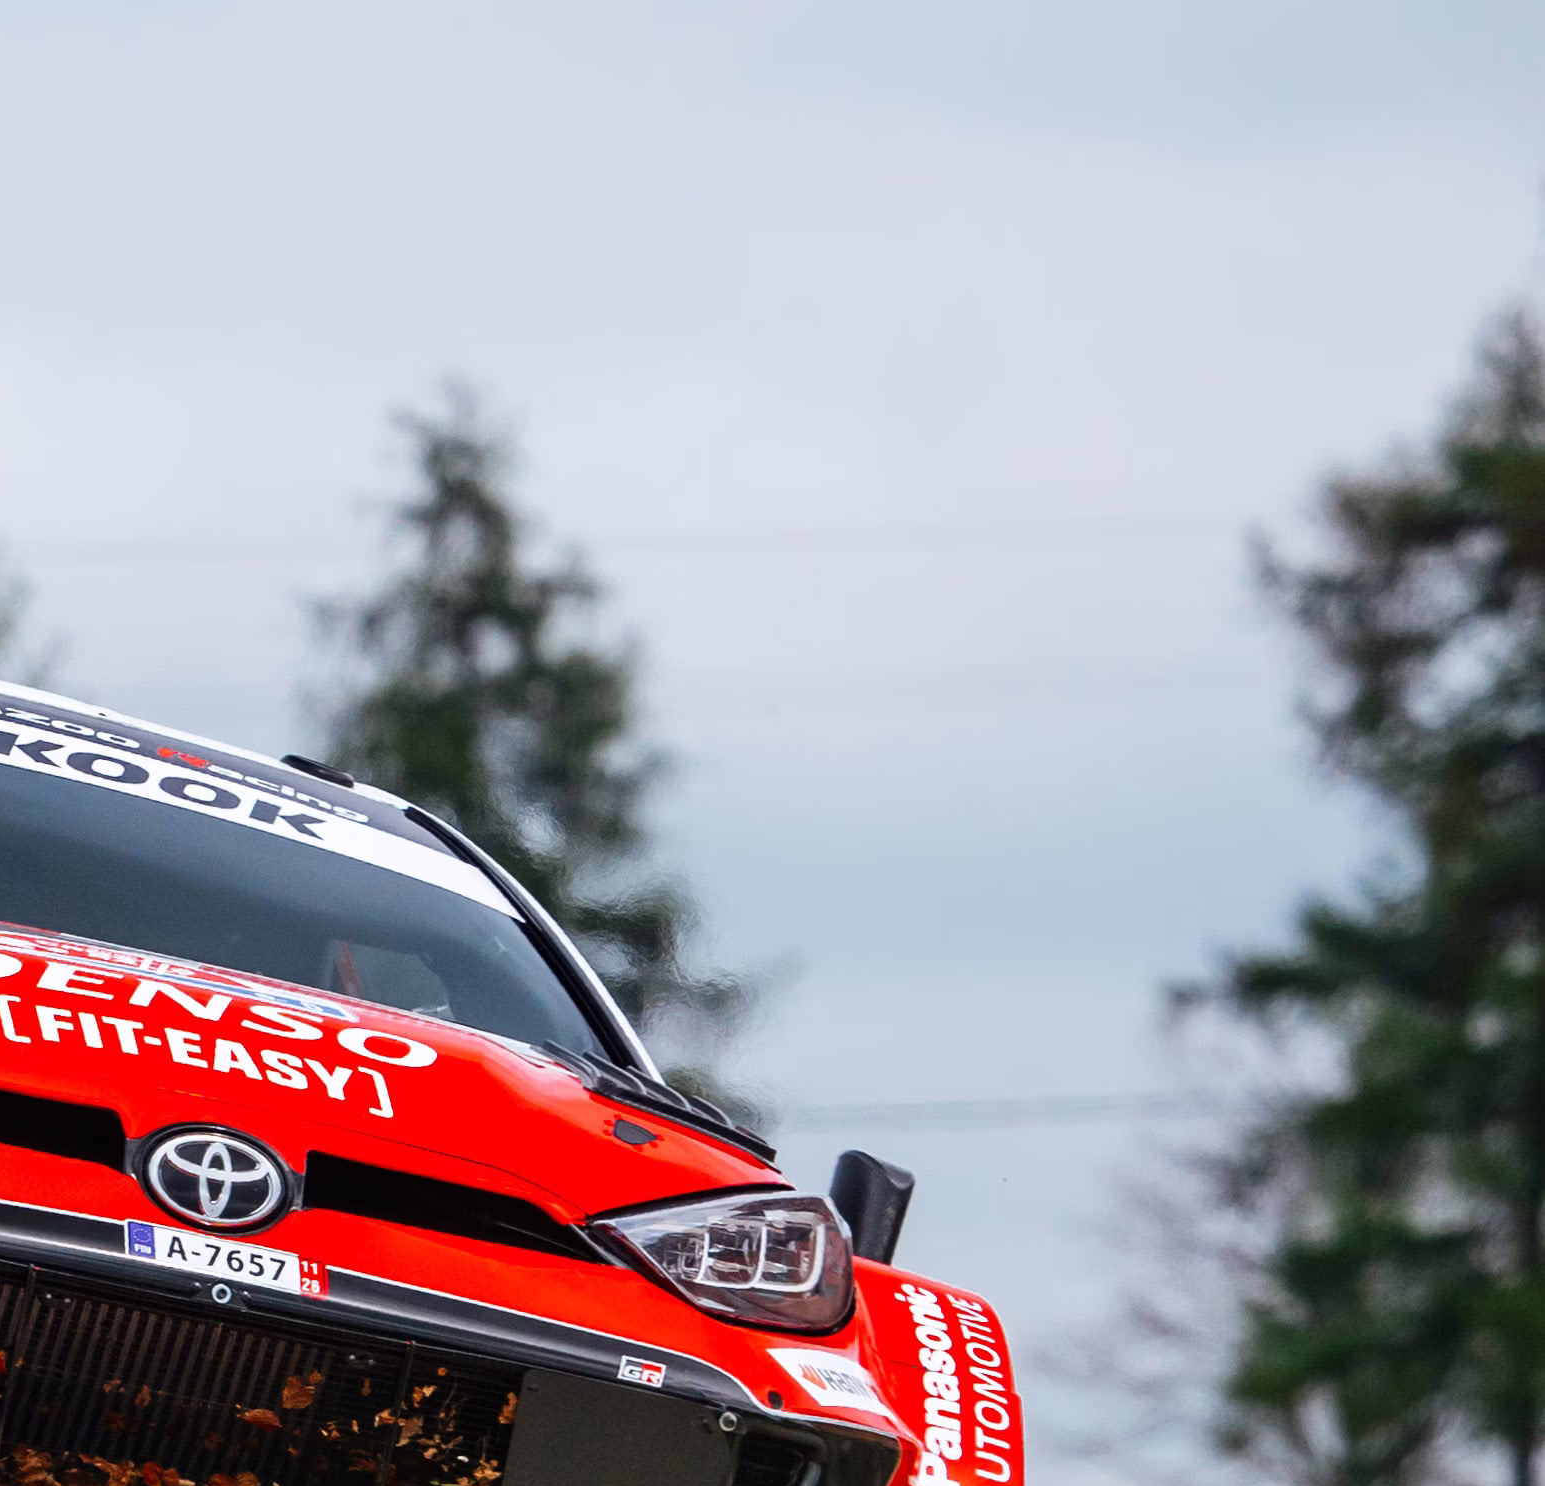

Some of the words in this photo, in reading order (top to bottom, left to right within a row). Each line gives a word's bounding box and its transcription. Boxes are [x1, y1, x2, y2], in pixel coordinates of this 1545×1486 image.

[156, 745, 370, 824] Racing
[166, 1236, 287, 1281] A-7657
[300, 1260, 319, 1275] 11
[622, 1364, 662, 1385] GR
